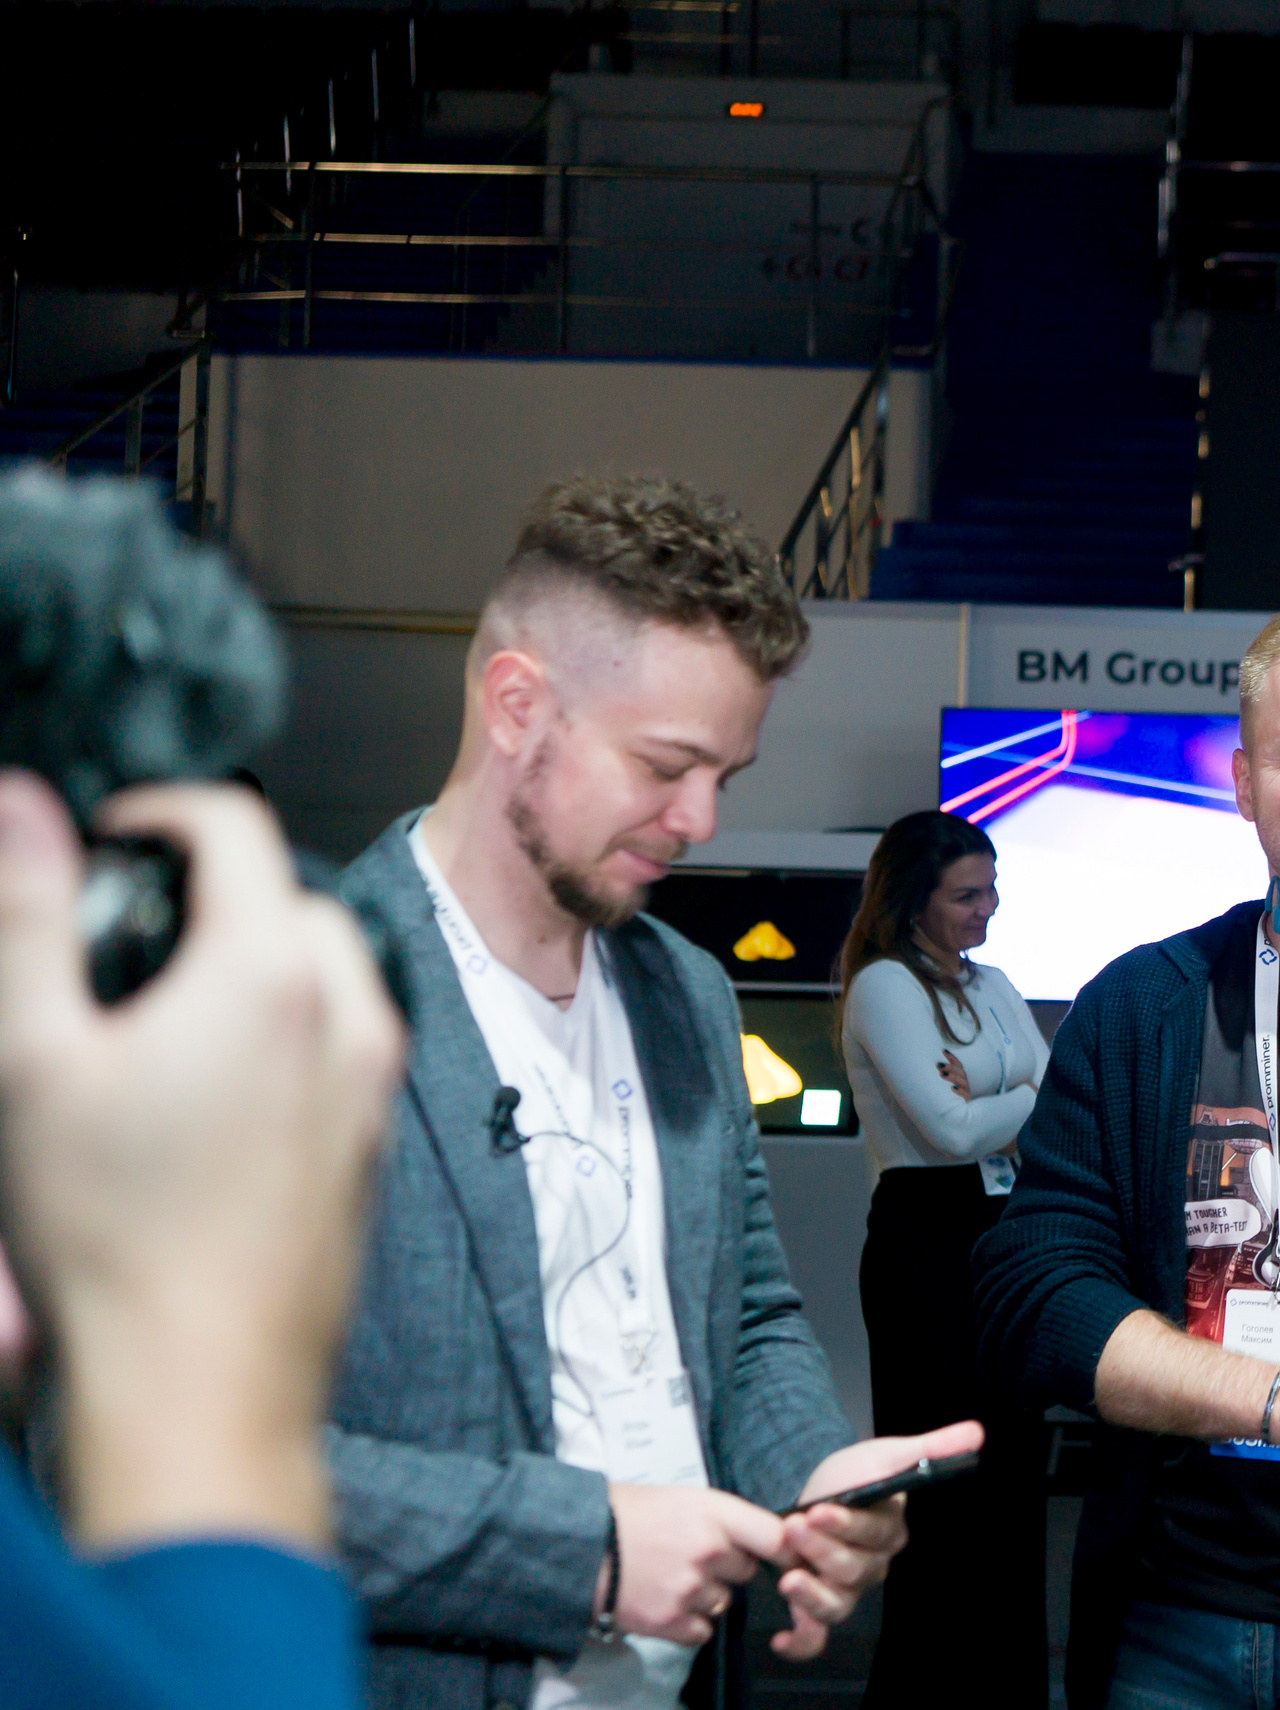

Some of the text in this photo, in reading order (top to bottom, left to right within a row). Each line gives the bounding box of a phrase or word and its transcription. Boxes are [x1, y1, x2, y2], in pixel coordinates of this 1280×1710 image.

[1017, 650, 1088, 683] BM
[1193, 1206, 1228, 1219] TOUGHER
[1203, 1223, 1209, 1233] A
[1241, 1323, 1274, 1334] Гоголев
[1240, 1334, 1273, 1344] Максим
